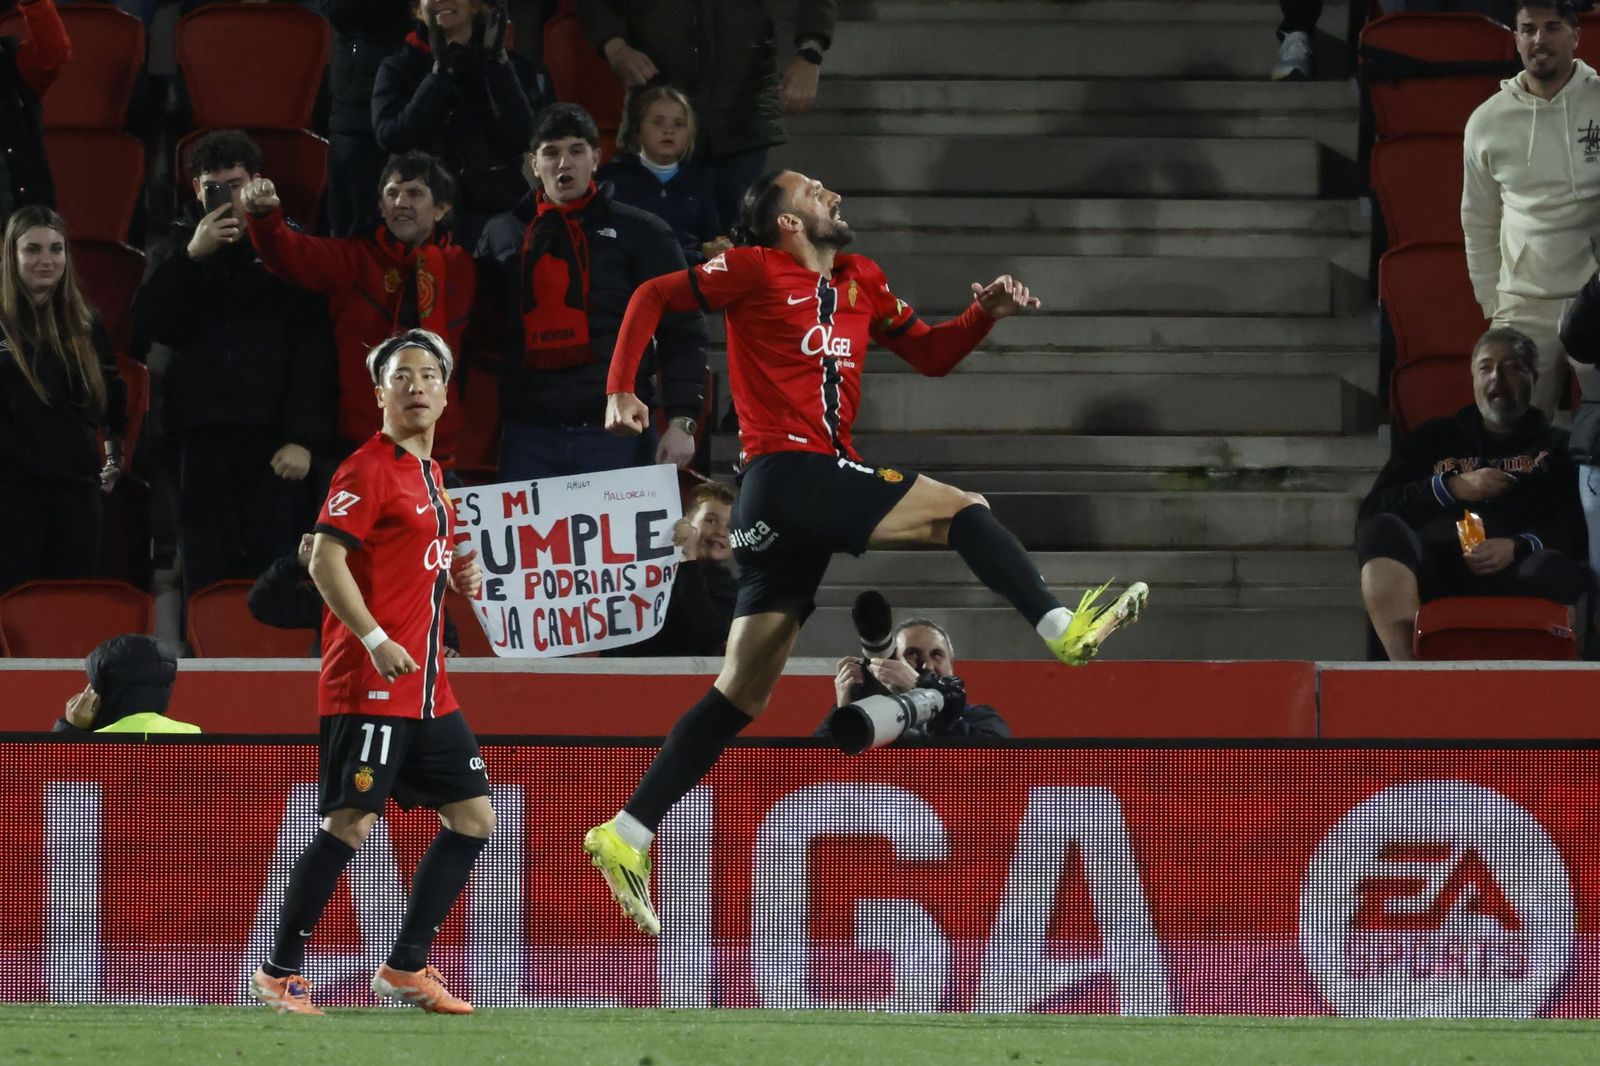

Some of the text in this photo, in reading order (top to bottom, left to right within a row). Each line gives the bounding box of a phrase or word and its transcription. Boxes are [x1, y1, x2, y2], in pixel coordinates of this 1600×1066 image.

[361, 722, 393, 765] 11
[44, 780, 1177, 1018] LALIGA
[1349, 840, 1524, 932] EA
